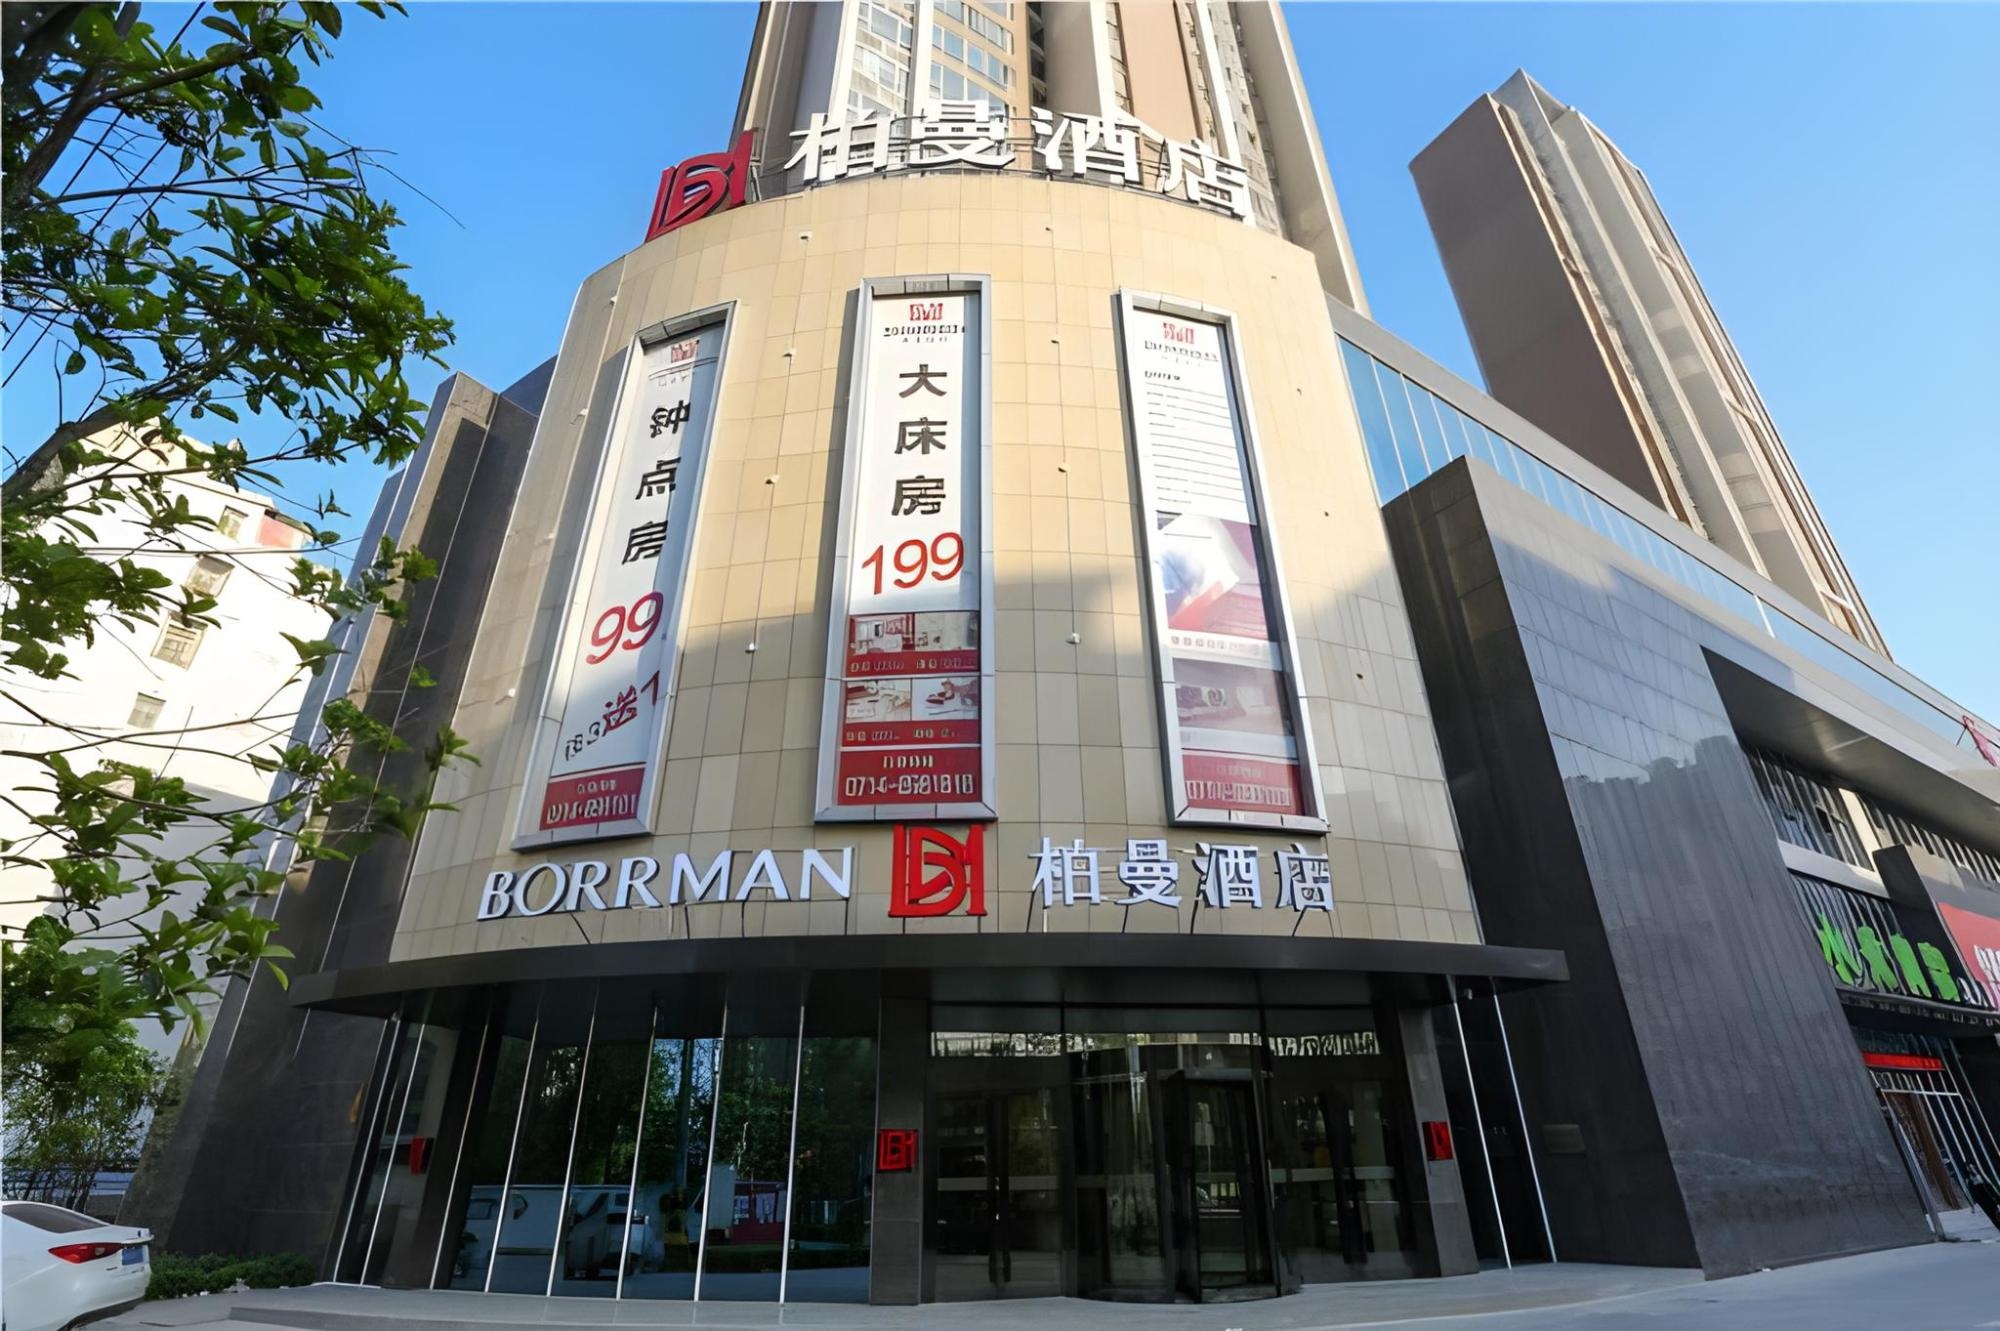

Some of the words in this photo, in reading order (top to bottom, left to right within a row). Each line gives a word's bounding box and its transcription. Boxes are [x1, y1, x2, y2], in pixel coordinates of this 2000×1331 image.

[783, 99, 1248, 223] 柏曼酒店
[891, 364, 948, 516] 大床房
[861, 532, 965, 595] 199
[586, 592, 664, 665] 99
[477, 846, 854, 921] BORRMAN
[1027, 836, 1334, 911] 柏曼酒店
